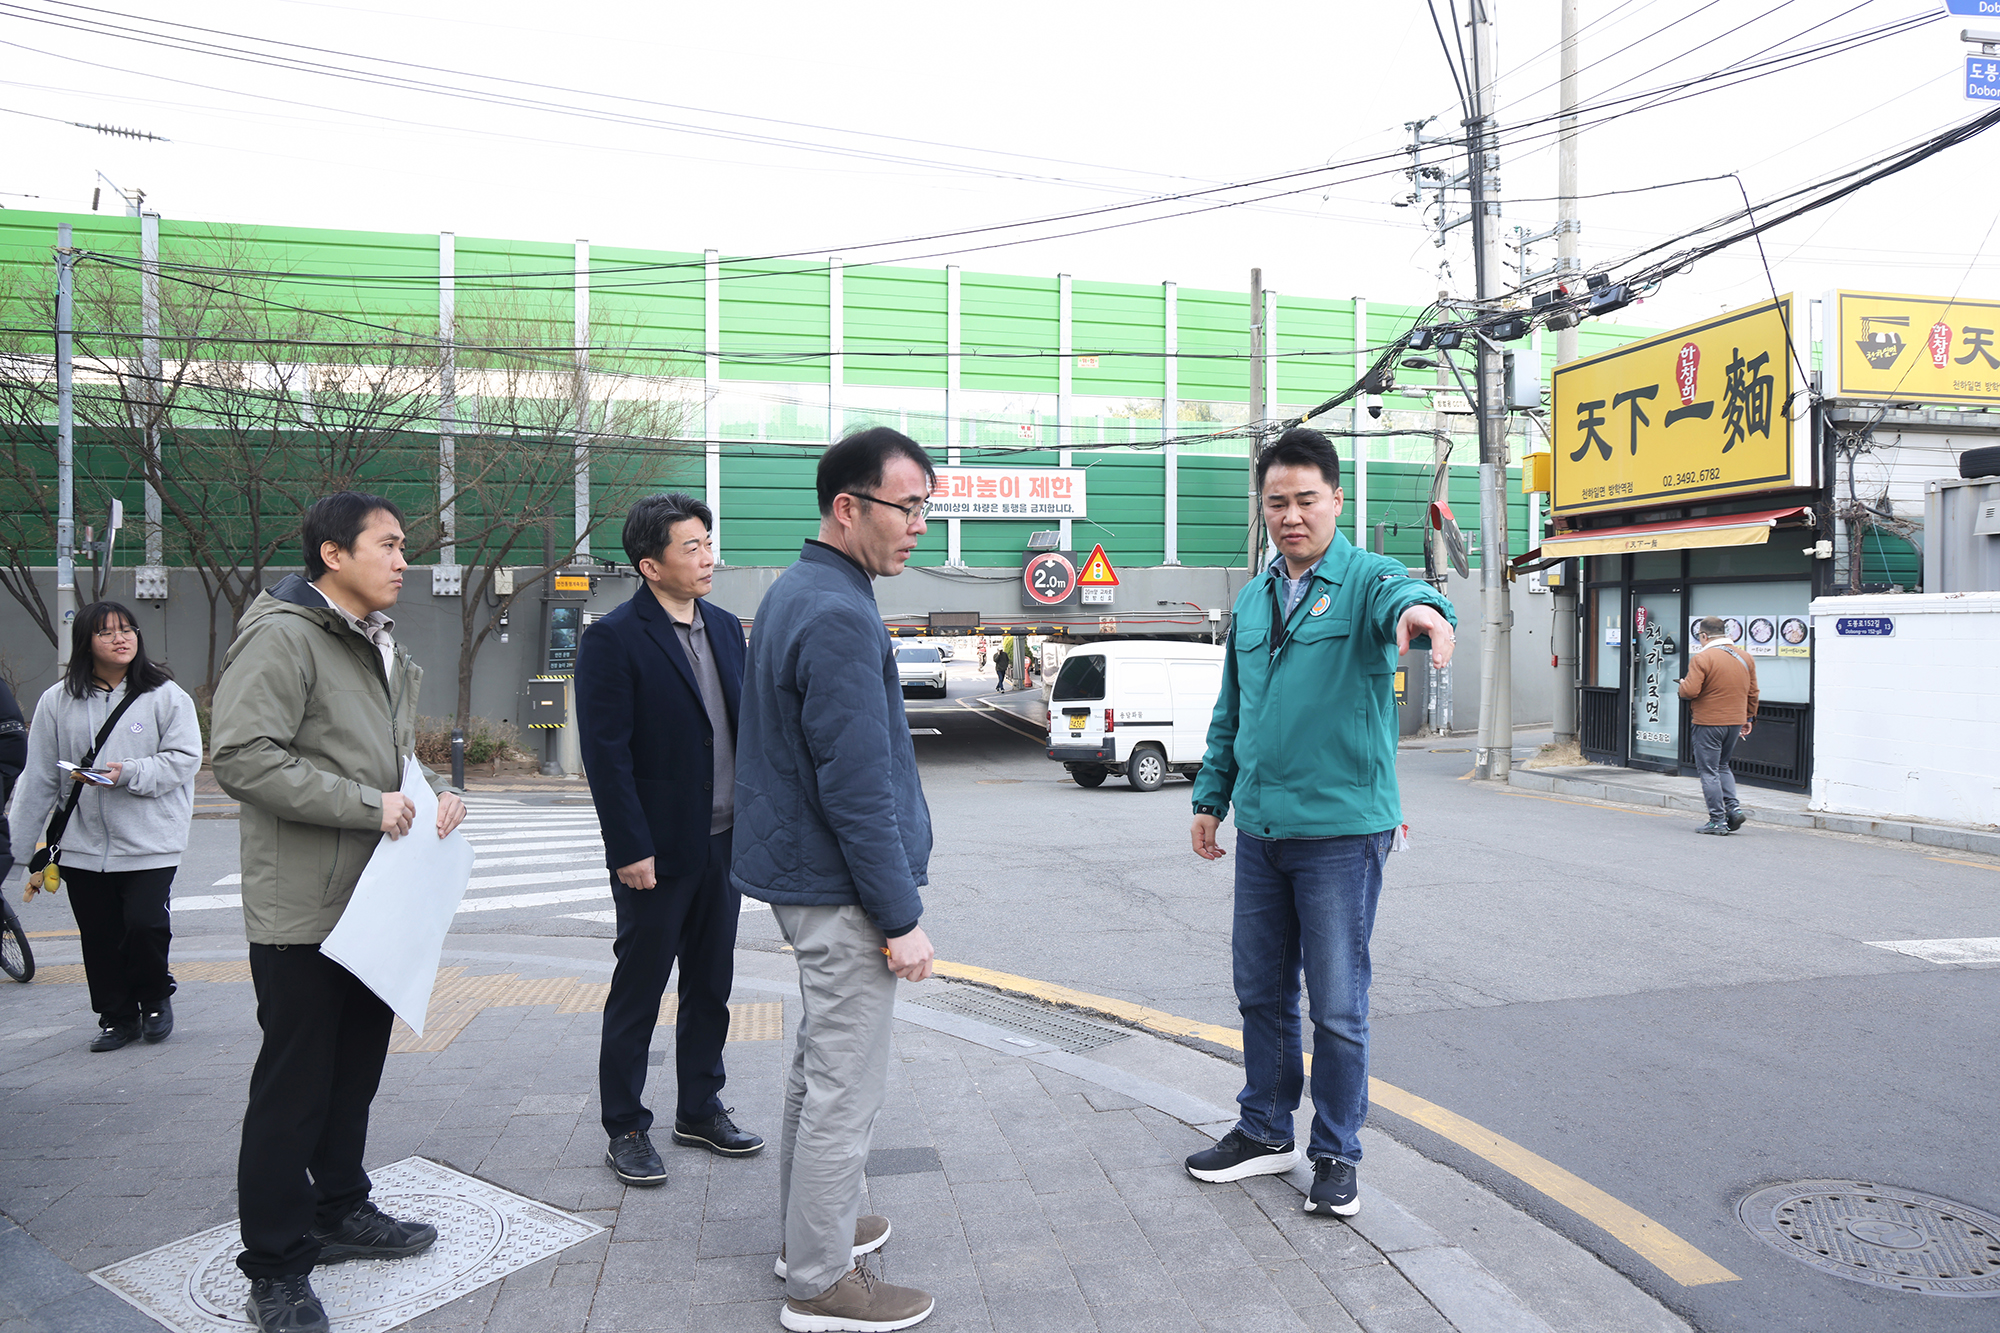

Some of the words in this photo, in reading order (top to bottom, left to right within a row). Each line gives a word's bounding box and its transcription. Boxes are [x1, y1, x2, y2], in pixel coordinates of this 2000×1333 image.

[1969, 63, 2000, 82] 도봉
[1932, 324, 1949, 366] 한창희
[1954, 326, 2000, 370] 天
[1678, 345, 1698, 402] 한창희
[1953, 379, 1982, 392] 천하일면
[928, 475, 1020, 499] 통과높이
[1029, 476, 1073, 499] 제한
[1662, 467, 1720, 487] 02.3492.6782
[1581, 486, 1606, 500] 천하일면
[972, 503, 999, 513] 차량은
[1002, 504, 1028, 513] 통행을
[1030, 504, 1075, 514] 금지합니다.
[1034, 568, 1066, 588] 2.0m
[1846, 619, 1881, 628] 도봉로152길
[1645, 622, 1664, 723] 천하일면
